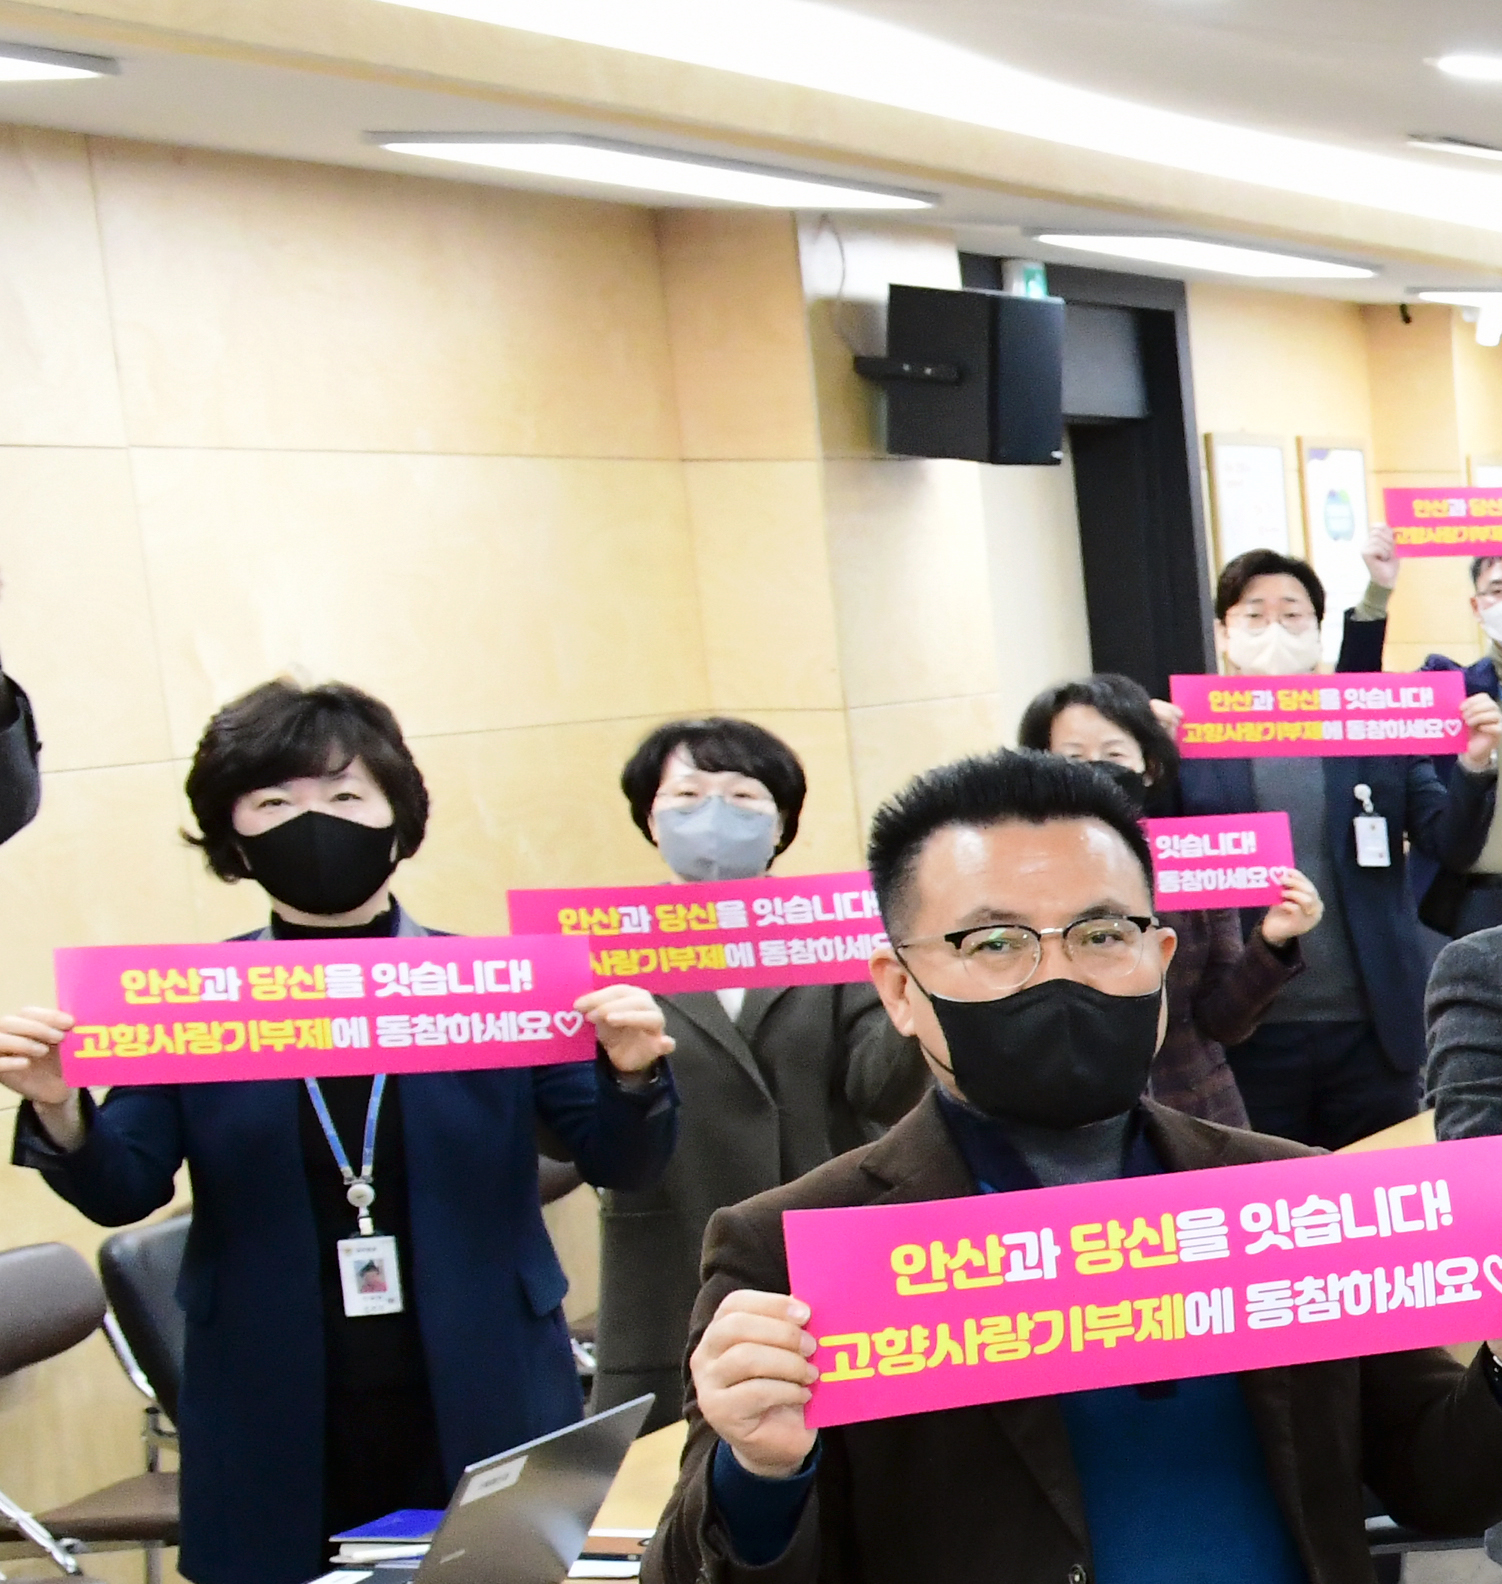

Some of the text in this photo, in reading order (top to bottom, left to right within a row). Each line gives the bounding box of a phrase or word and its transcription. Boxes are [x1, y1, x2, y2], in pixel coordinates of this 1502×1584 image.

[1156, 831, 1256, 859] 잇습니다!
[1158, 866, 1269, 893] 동참하세요
[558, 906, 651, 935] 안산과
[656, 900, 748, 932] 당신을
[589, 942, 755, 976] 사랑기부제에
[121, 959, 532, 1004] 안산과 당신을 잇습니다!
[72, 1011, 553, 1058] 고향사랑기부제에 동참하세요
[891, 1179, 1453, 1295] 안산과 당신을 잇습니다!
[819, 1257, 1482, 1382] 고향사랑기부제에 동참하세요
